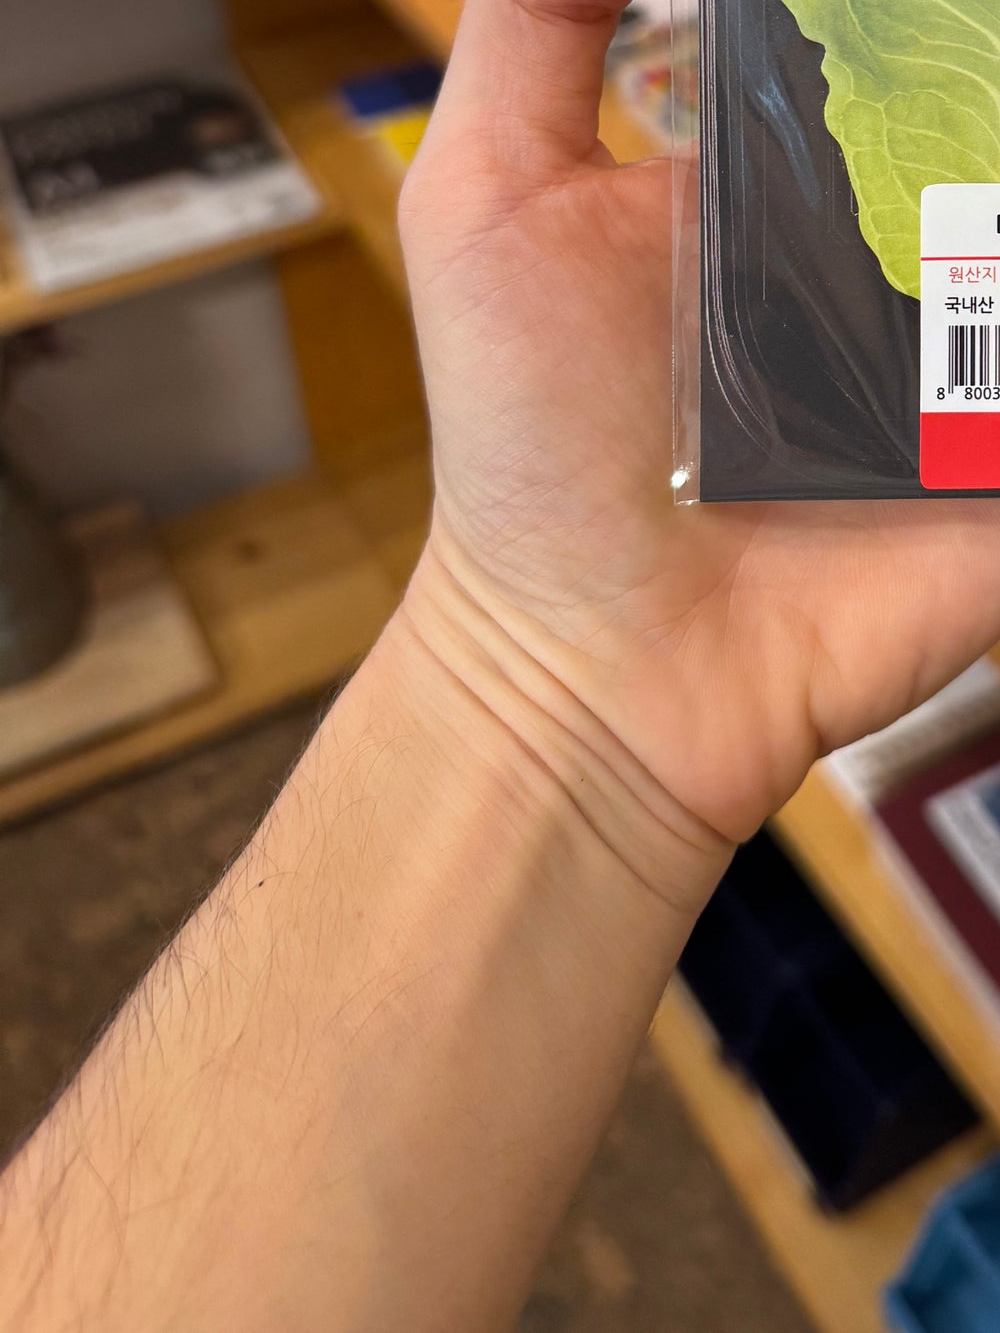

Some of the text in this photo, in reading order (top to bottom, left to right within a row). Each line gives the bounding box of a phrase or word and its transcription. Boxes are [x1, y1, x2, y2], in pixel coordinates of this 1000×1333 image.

[949, 265, 997, 284] 원산지
[944, 296, 994, 314] 국내산
[936, 387, 946, 400] 8
